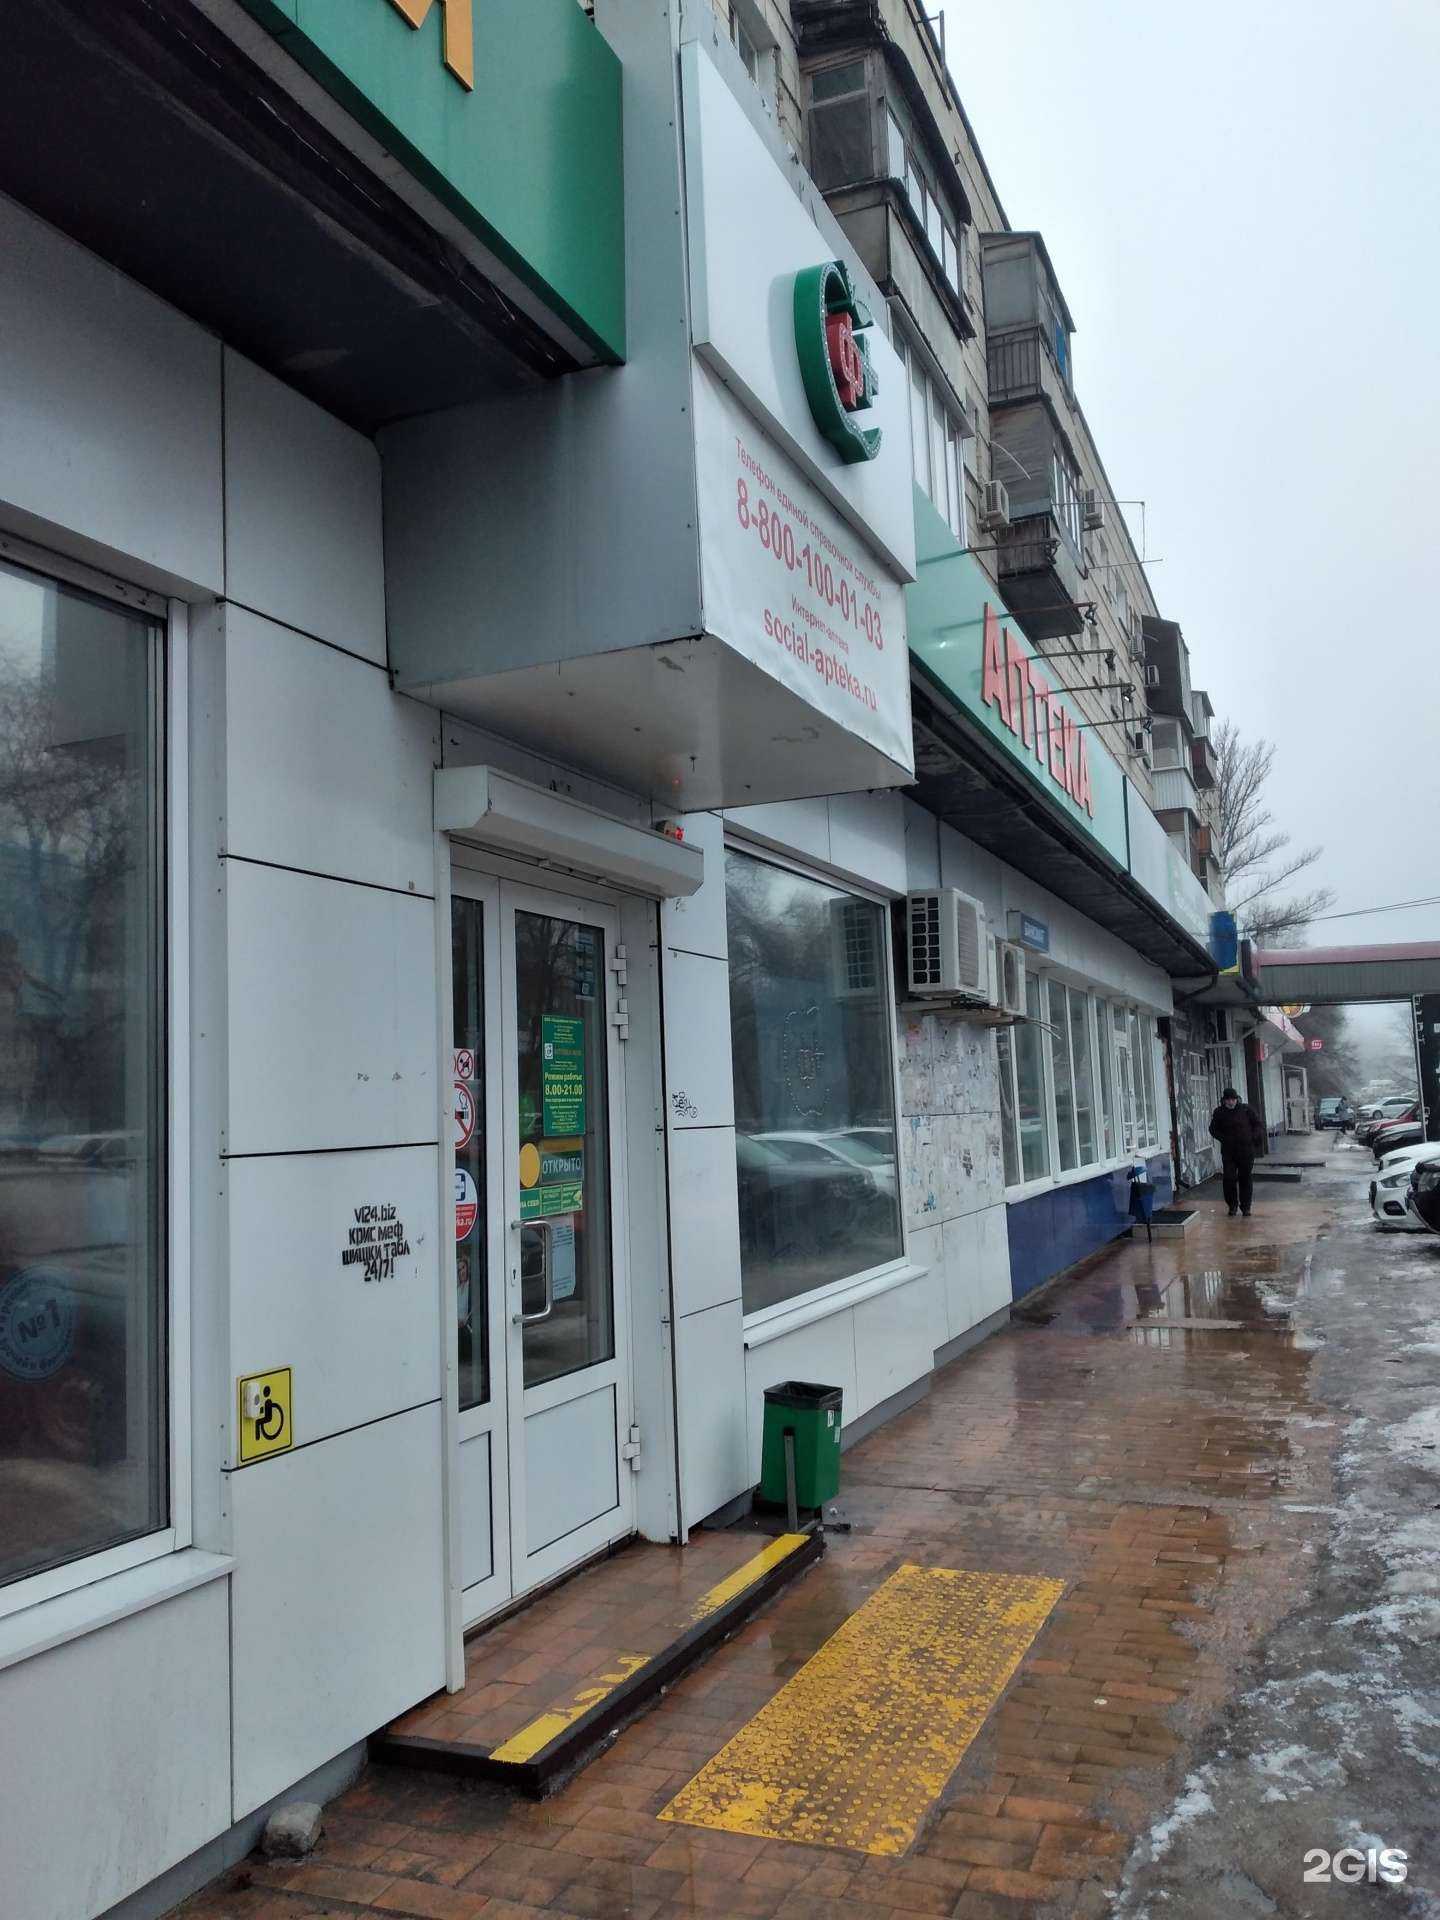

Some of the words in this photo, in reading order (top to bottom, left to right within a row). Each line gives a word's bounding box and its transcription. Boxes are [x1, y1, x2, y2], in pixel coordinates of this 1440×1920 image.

[736, 437, 776, 496] Телефон
[777, 488, 809, 529] единой
[810, 520, 853, 573] справочной
[738, 478, 883, 650] 8-800-100-01-03
[764, 608, 877, 712] social-apteka.ru
[981, 602, 1093, 820] АПТЕКА
[542, 1157, 582, 1175] ОТКРЫТО
